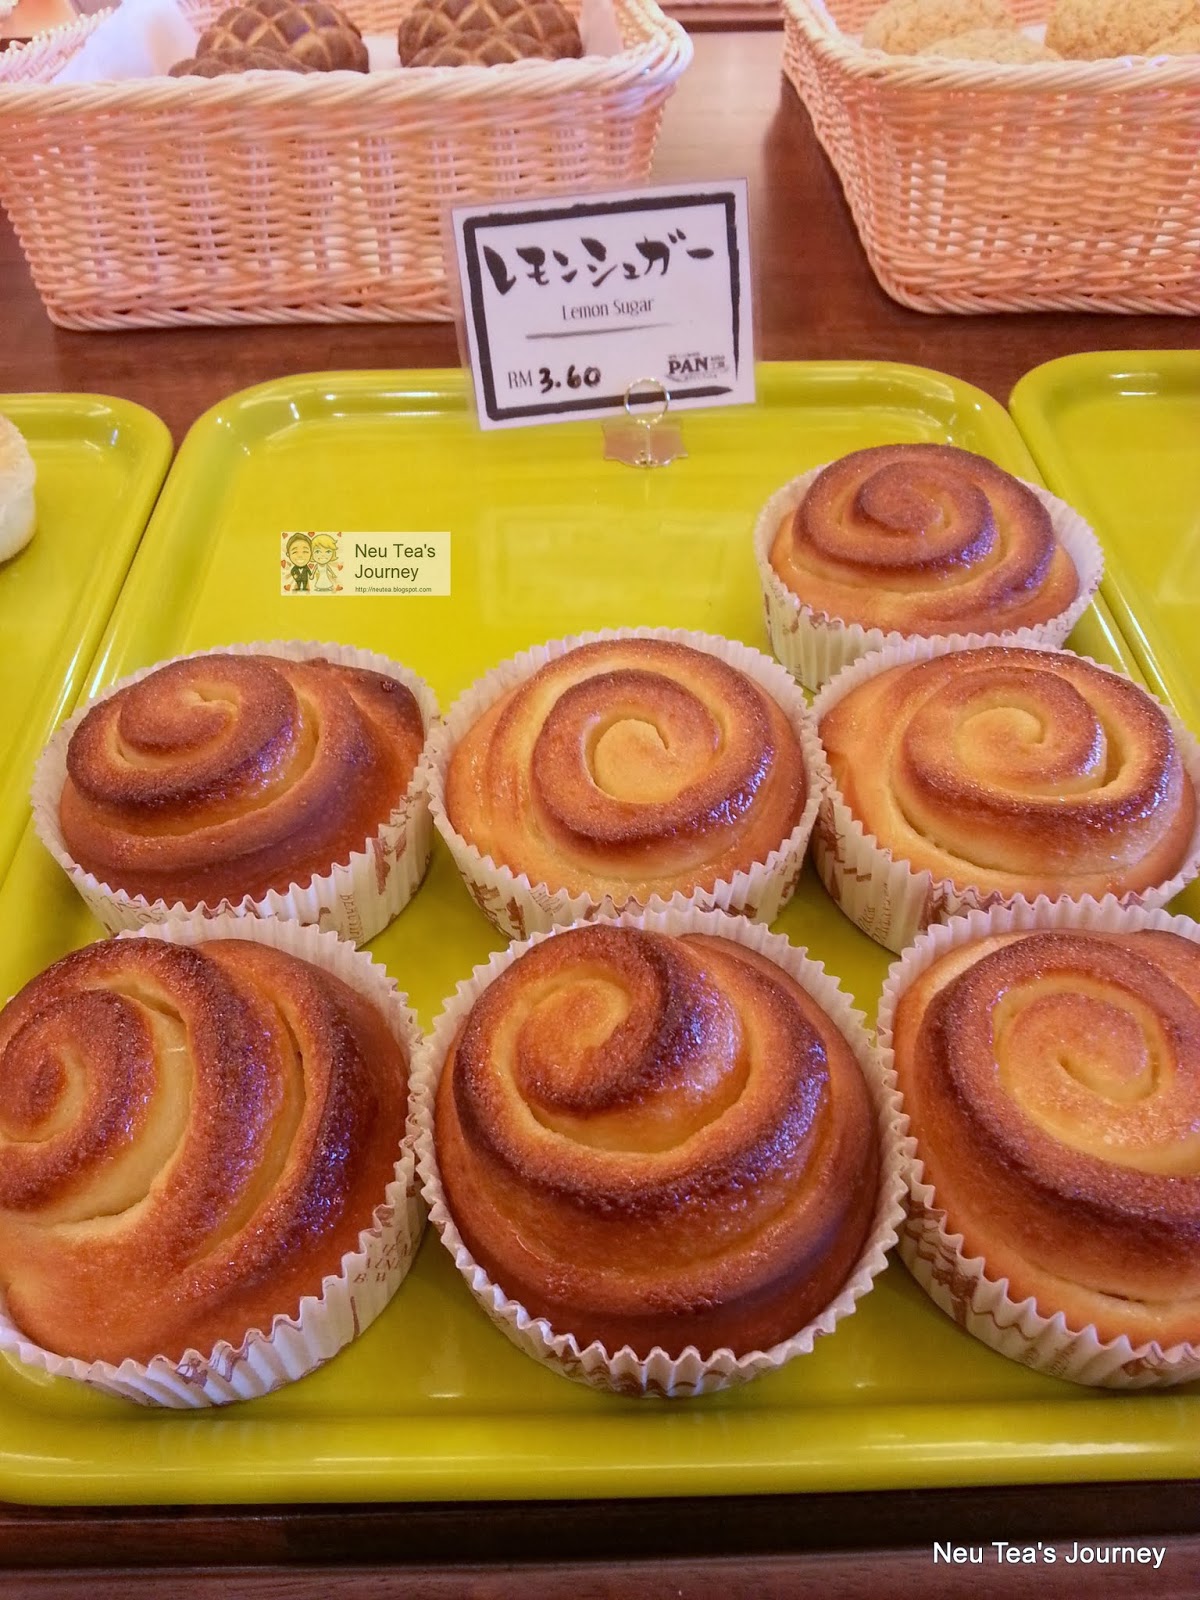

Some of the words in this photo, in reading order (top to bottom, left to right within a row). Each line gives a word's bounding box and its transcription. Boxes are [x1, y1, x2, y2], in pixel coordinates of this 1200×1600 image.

[483, 228, 714, 296] レモンシュガー
[562, 302, 609, 321] Lemon
[613, 298, 655, 317] Sugar
[668, 356, 708, 375] PAN
[508, 369, 533, 390] RM
[538, 364, 602, 394] 3.60
